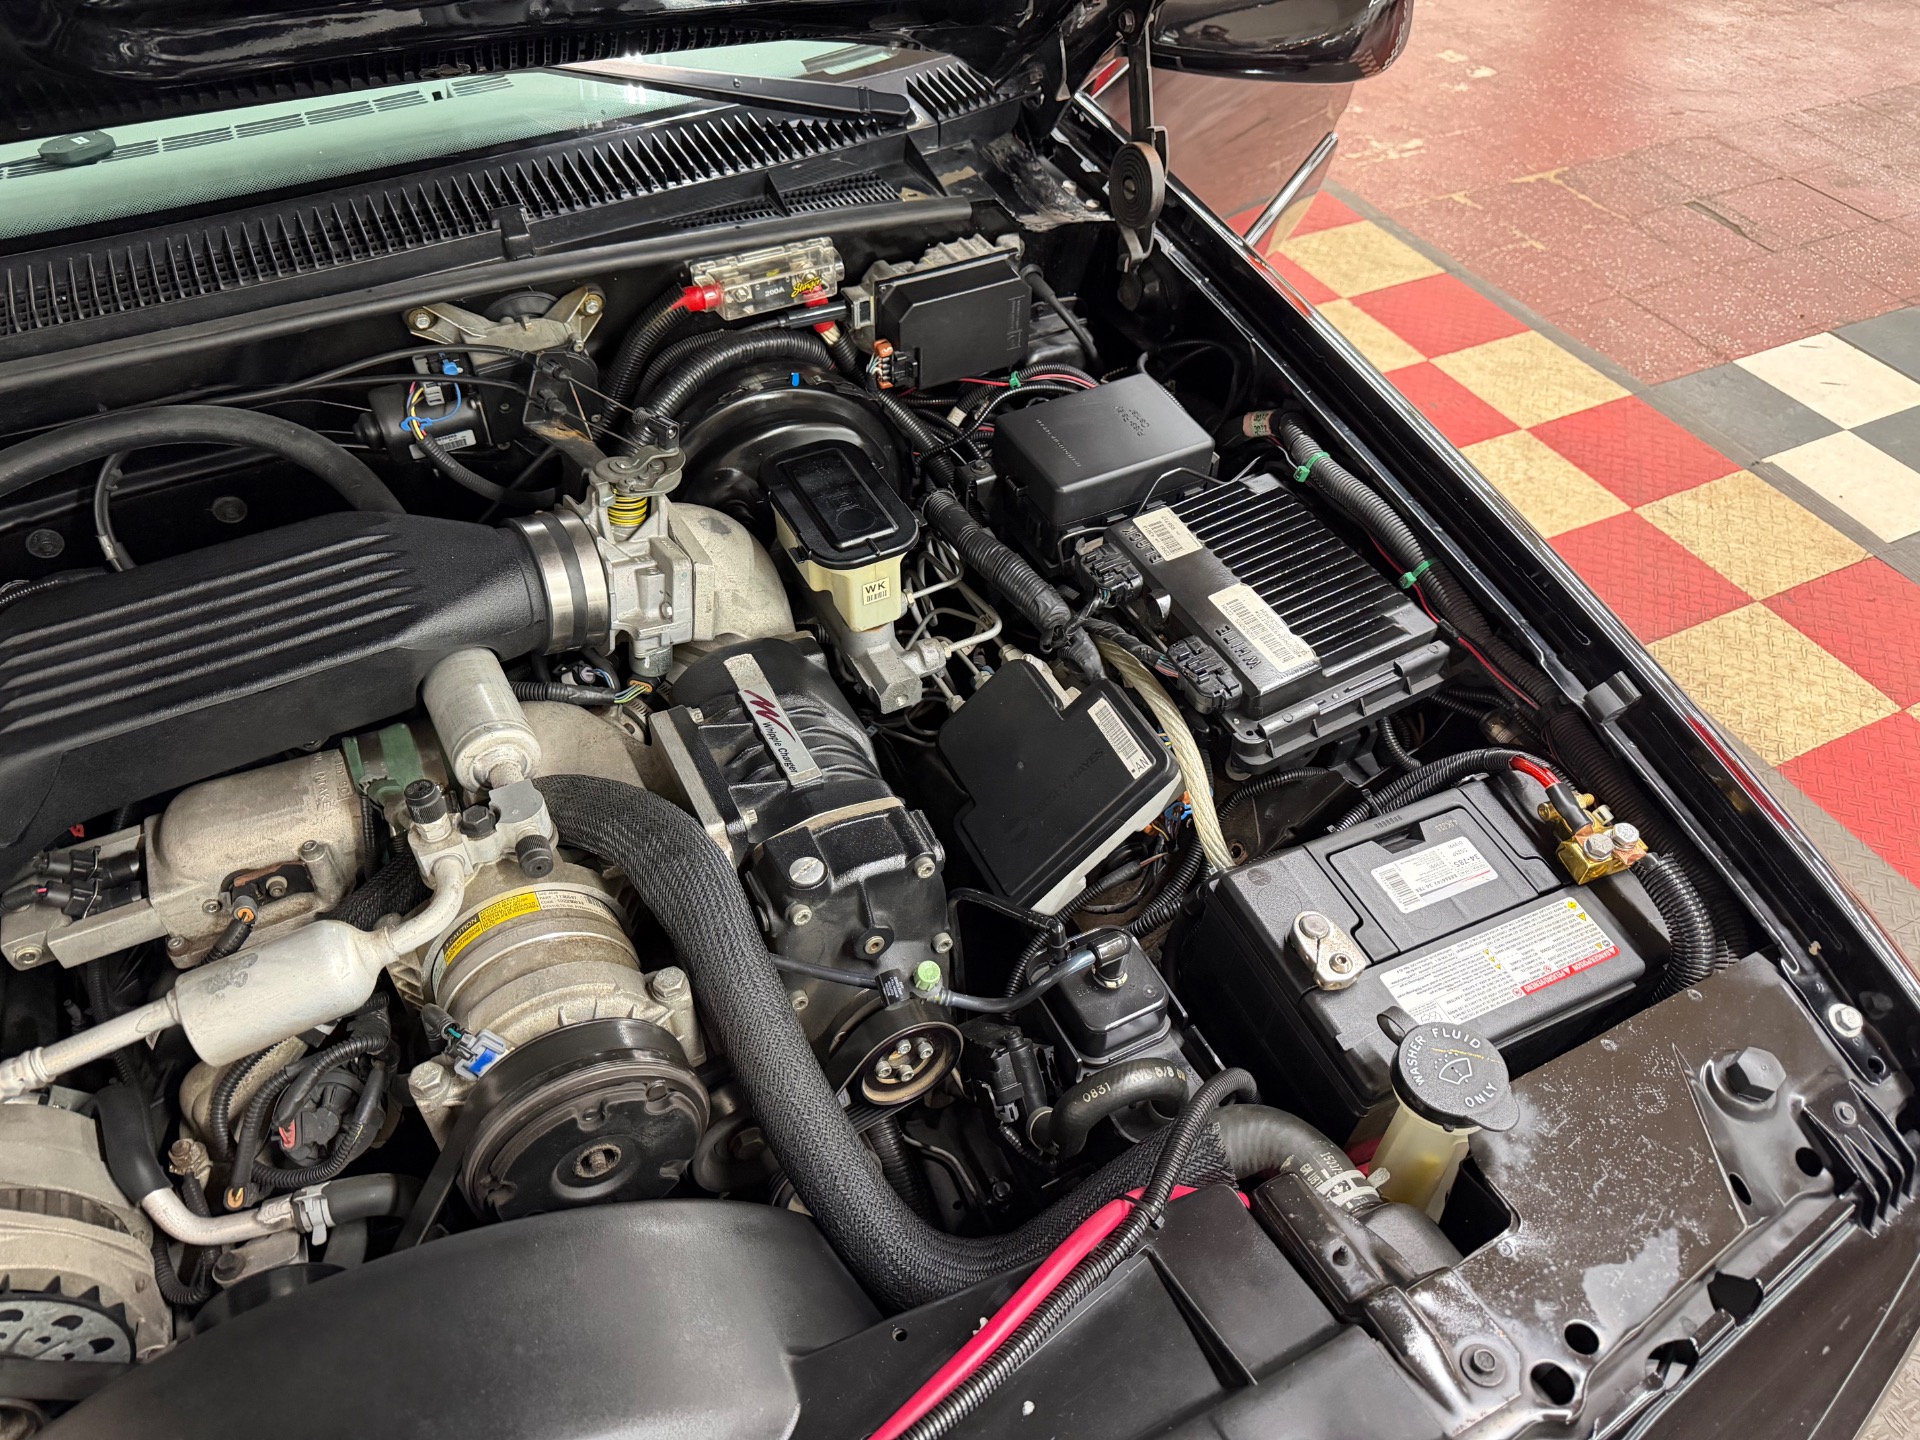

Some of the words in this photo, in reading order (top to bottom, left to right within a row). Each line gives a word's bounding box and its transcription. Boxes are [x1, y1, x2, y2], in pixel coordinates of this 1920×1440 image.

[765, 288, 785, 297] 200A
[790, 277, 822, 298] Stinger
[864, 580, 886, 594] WK
[1214, 624, 1263, 670] WHITE
[761, 719, 783, 747] Whipple
[777, 745, 799, 774] Charger
[447, 916, 477, 944] CAUTION
[1081, 1081, 1112, 1103] 0831
[1153, 1064, 1175, 1078] 5/8
[1406, 1035, 1426, 1086] WASHER
[1431, 1027, 1481, 1048] FLUID
[1464, 1081, 1498, 1108] ONLY
